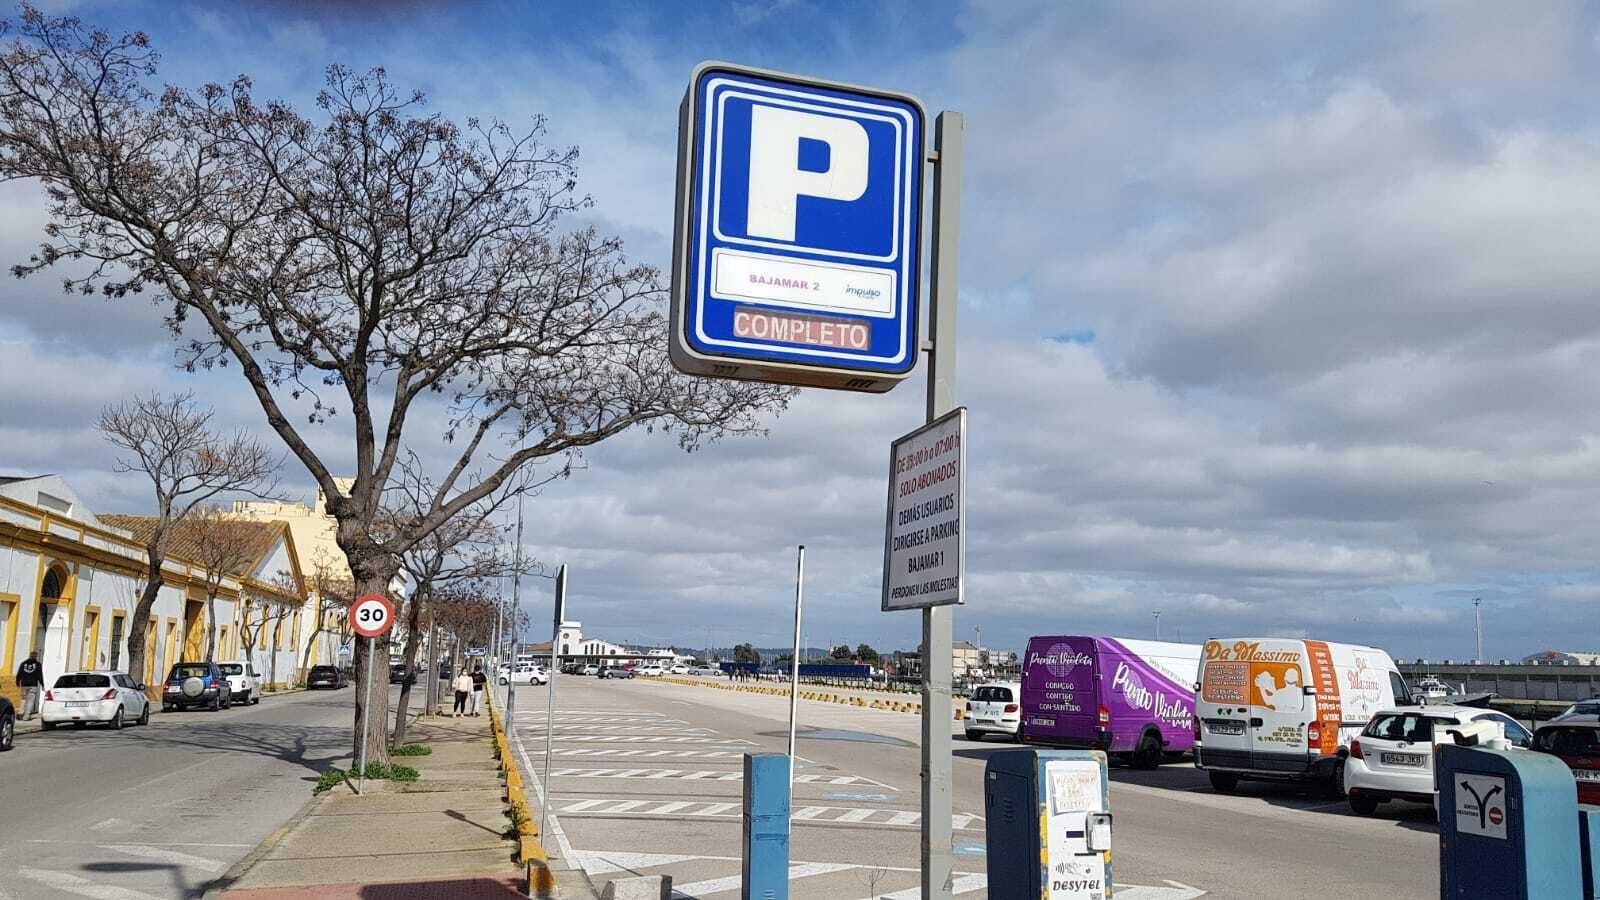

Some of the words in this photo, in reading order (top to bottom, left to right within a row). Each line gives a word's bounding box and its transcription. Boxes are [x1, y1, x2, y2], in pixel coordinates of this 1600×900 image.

[746, 103, 870, 241] P
[749, 274, 809, 290] BAJAMAR
[812, 282, 820, 291] 2
[845, 283, 881, 298] impulso
[734, 311, 868, 348] COMPLETO
[896, 457, 906, 475] DE
[935, 435, 954, 457] 07:00
[899, 477, 917, 498] SOLO
[917, 460, 957, 490] ABONADOS
[898, 502, 921, 526] DEMÁS
[921, 493, 954, 518] USUARIOS
[893, 529, 924, 552] DIRIGIRSE
[925, 529, 930, 544] A
[931, 518, 959, 543] PARKING
[908, 552, 939, 574] BAJAMAR
[891, 583, 919, 600] PERDONEN
[919, 581, 929, 595] LAS
[929, 576, 959, 593] MOLESTIAS
[360, 608, 384, 622] 30
[1030, 652, 1058, 667] Punto
[1060, 652, 1093, 667] Violeta
[1204, 640, 1231, 661] Da
[1233, 641, 1301, 662] Massimo
[1045, 681, 1075, 690] CONMIGO
[1045, 692, 1074, 700] CONTIGO
[1112, 662, 1154, 711] Punto
[1154, 690, 1193, 731] Violeta
